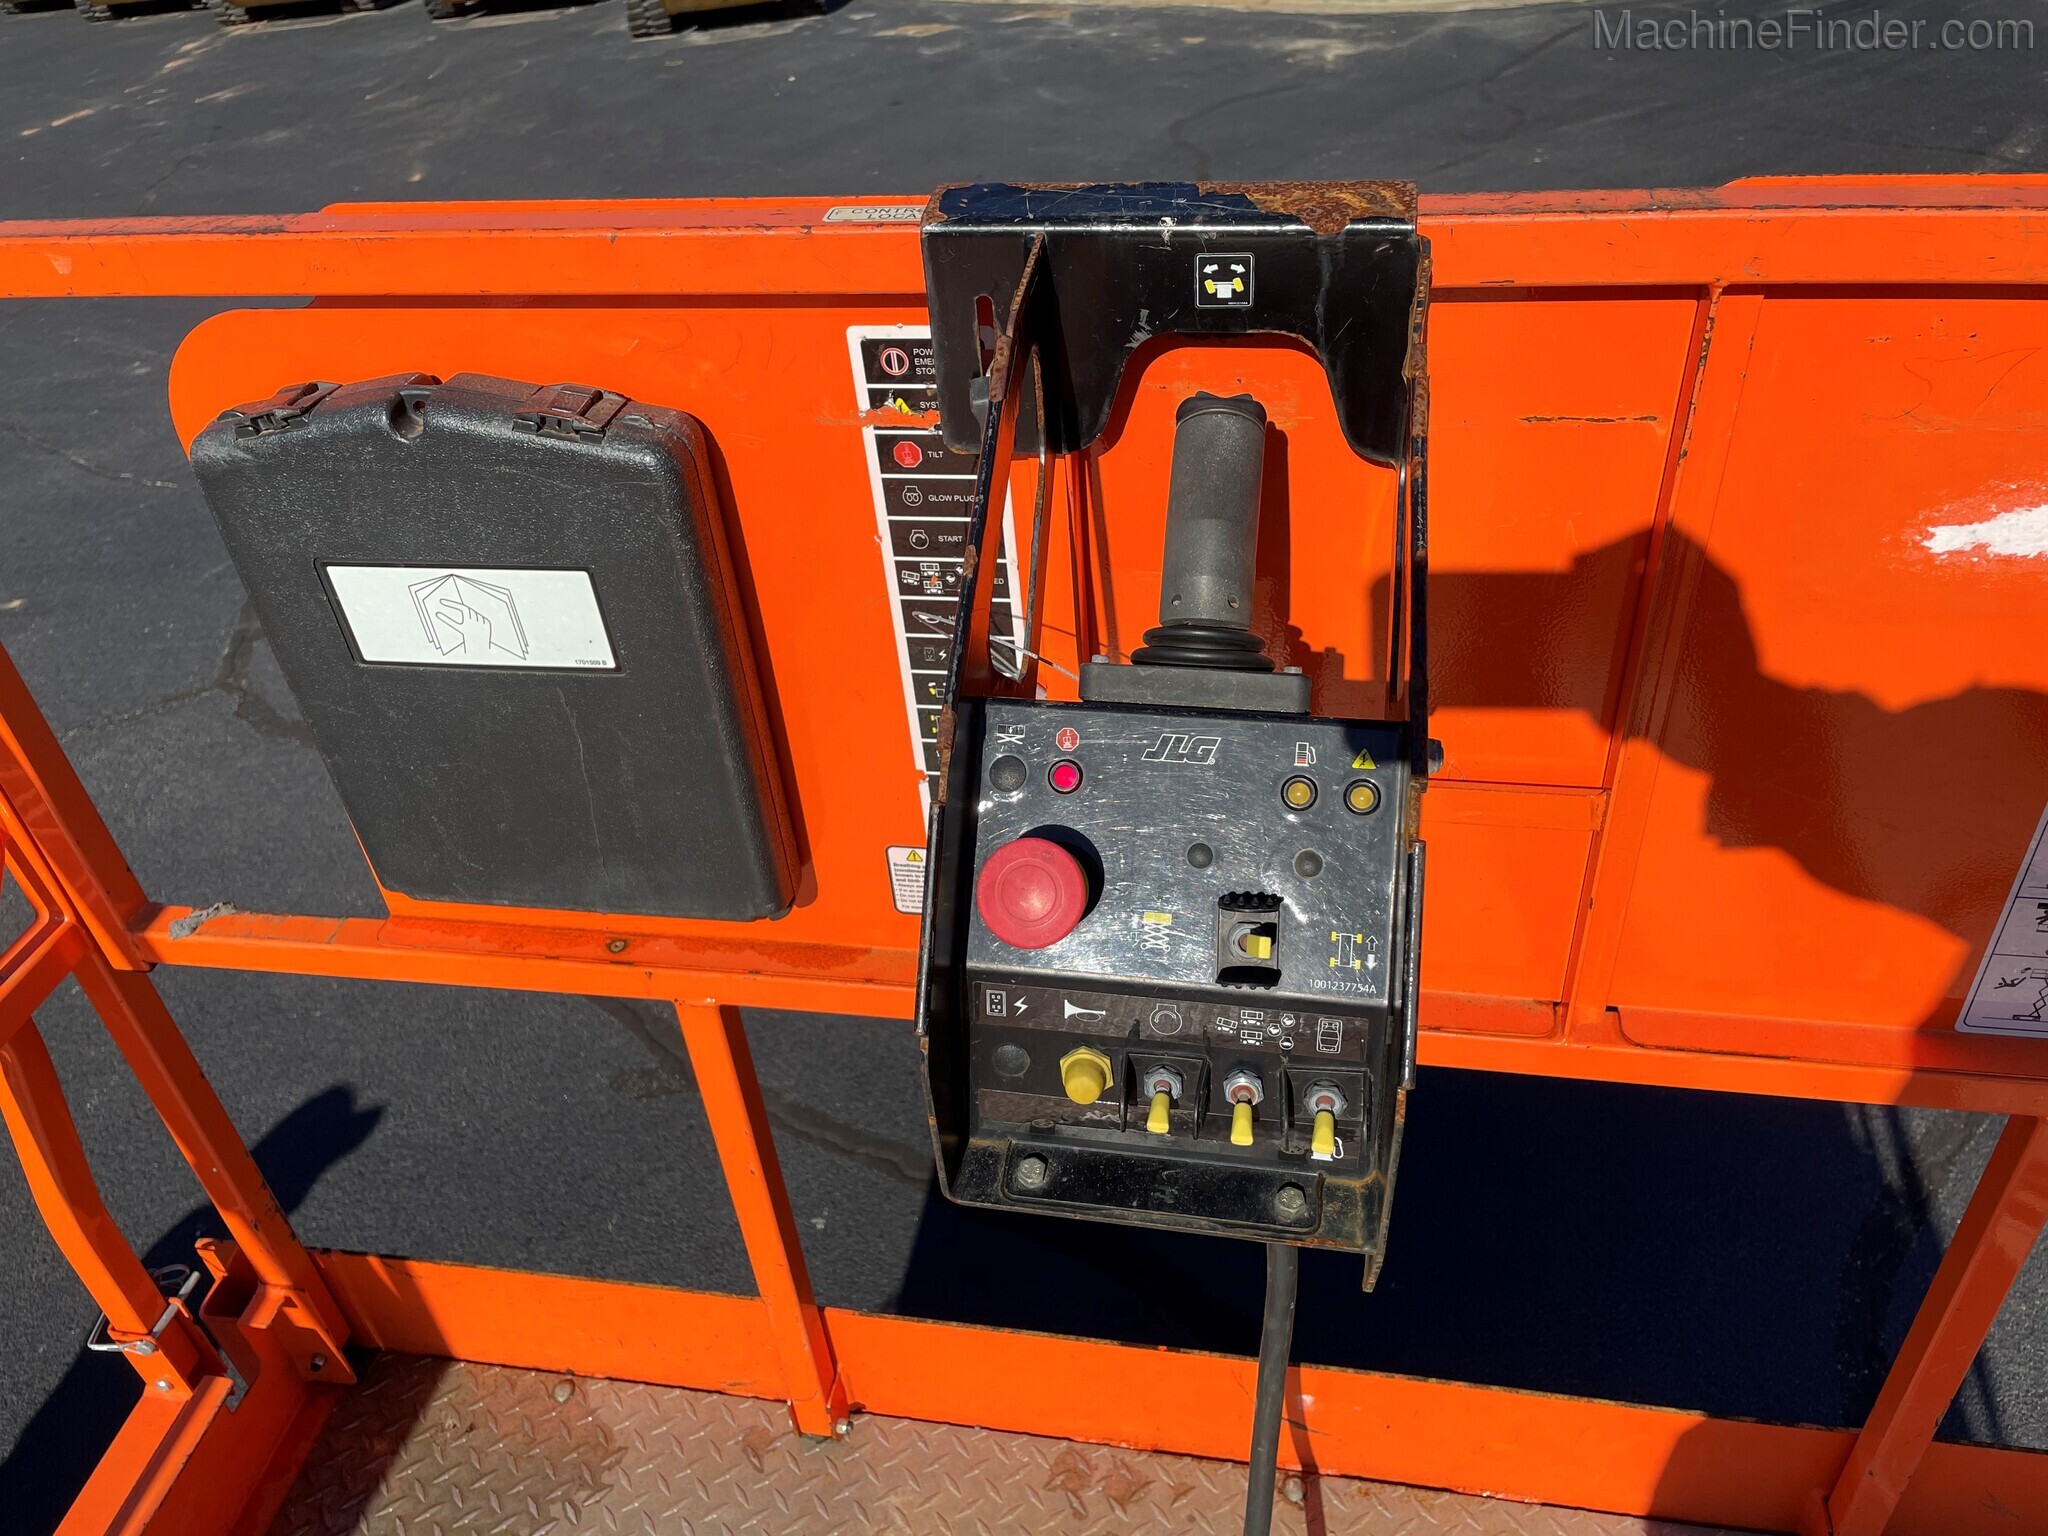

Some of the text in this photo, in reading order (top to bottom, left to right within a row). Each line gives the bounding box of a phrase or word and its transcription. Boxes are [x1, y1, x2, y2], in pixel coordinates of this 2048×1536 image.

[928, 494, 953, 502] GLOW
[938, 535, 963, 543] START
[1141, 733, 1222, 765] JLG
[1309, 979, 1377, 994] 1001237754A
